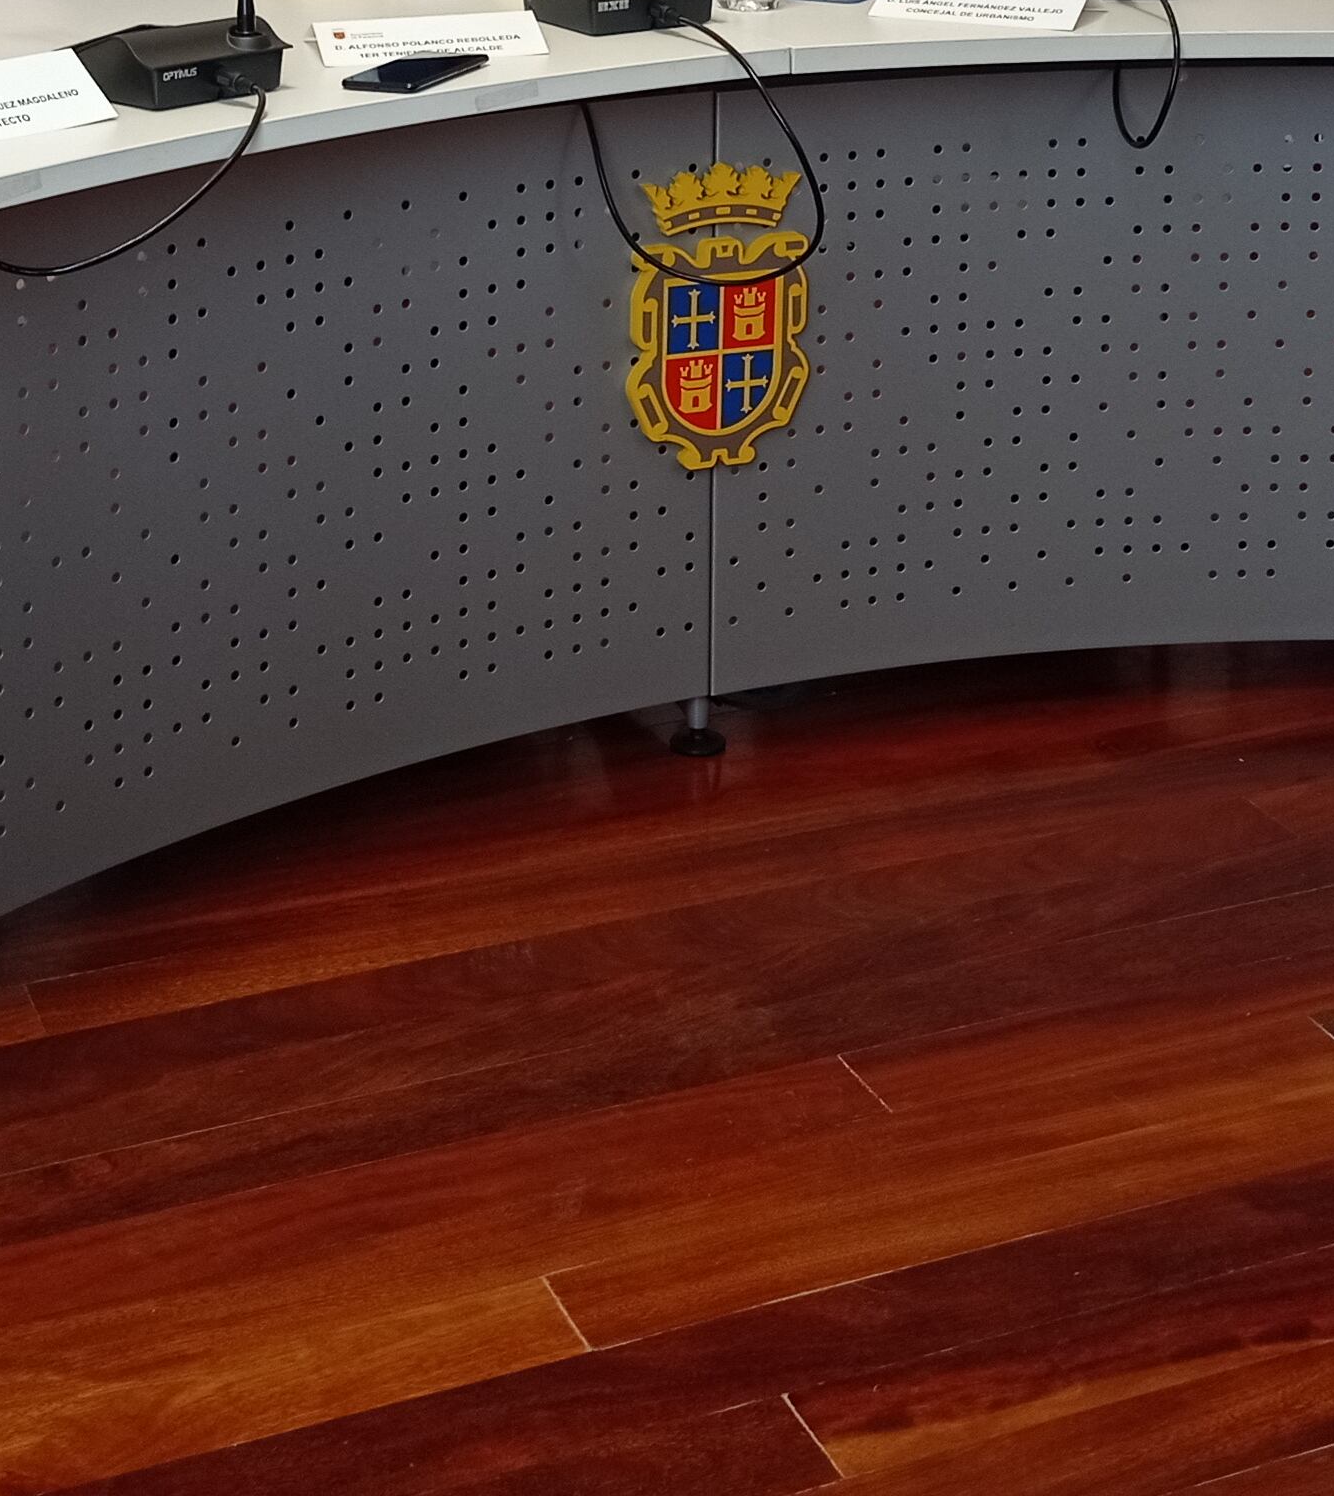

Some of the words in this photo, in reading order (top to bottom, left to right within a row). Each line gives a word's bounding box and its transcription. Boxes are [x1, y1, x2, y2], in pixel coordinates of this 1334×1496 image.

[906, 7, 956, 17] CONCEJAL
[975, 12, 1035, 22] URBANISMO
[1019, 6, 1063, 14] VALLEJO
[348, 41, 399, 50] ALFONSO
[402, 38, 454, 47] POLANCO
[456, 34, 521, 44] REBOLLEDA
[162, 67, 198, 82] OPTIMUS
[17, 88, 79, 106] MAGDALENO
